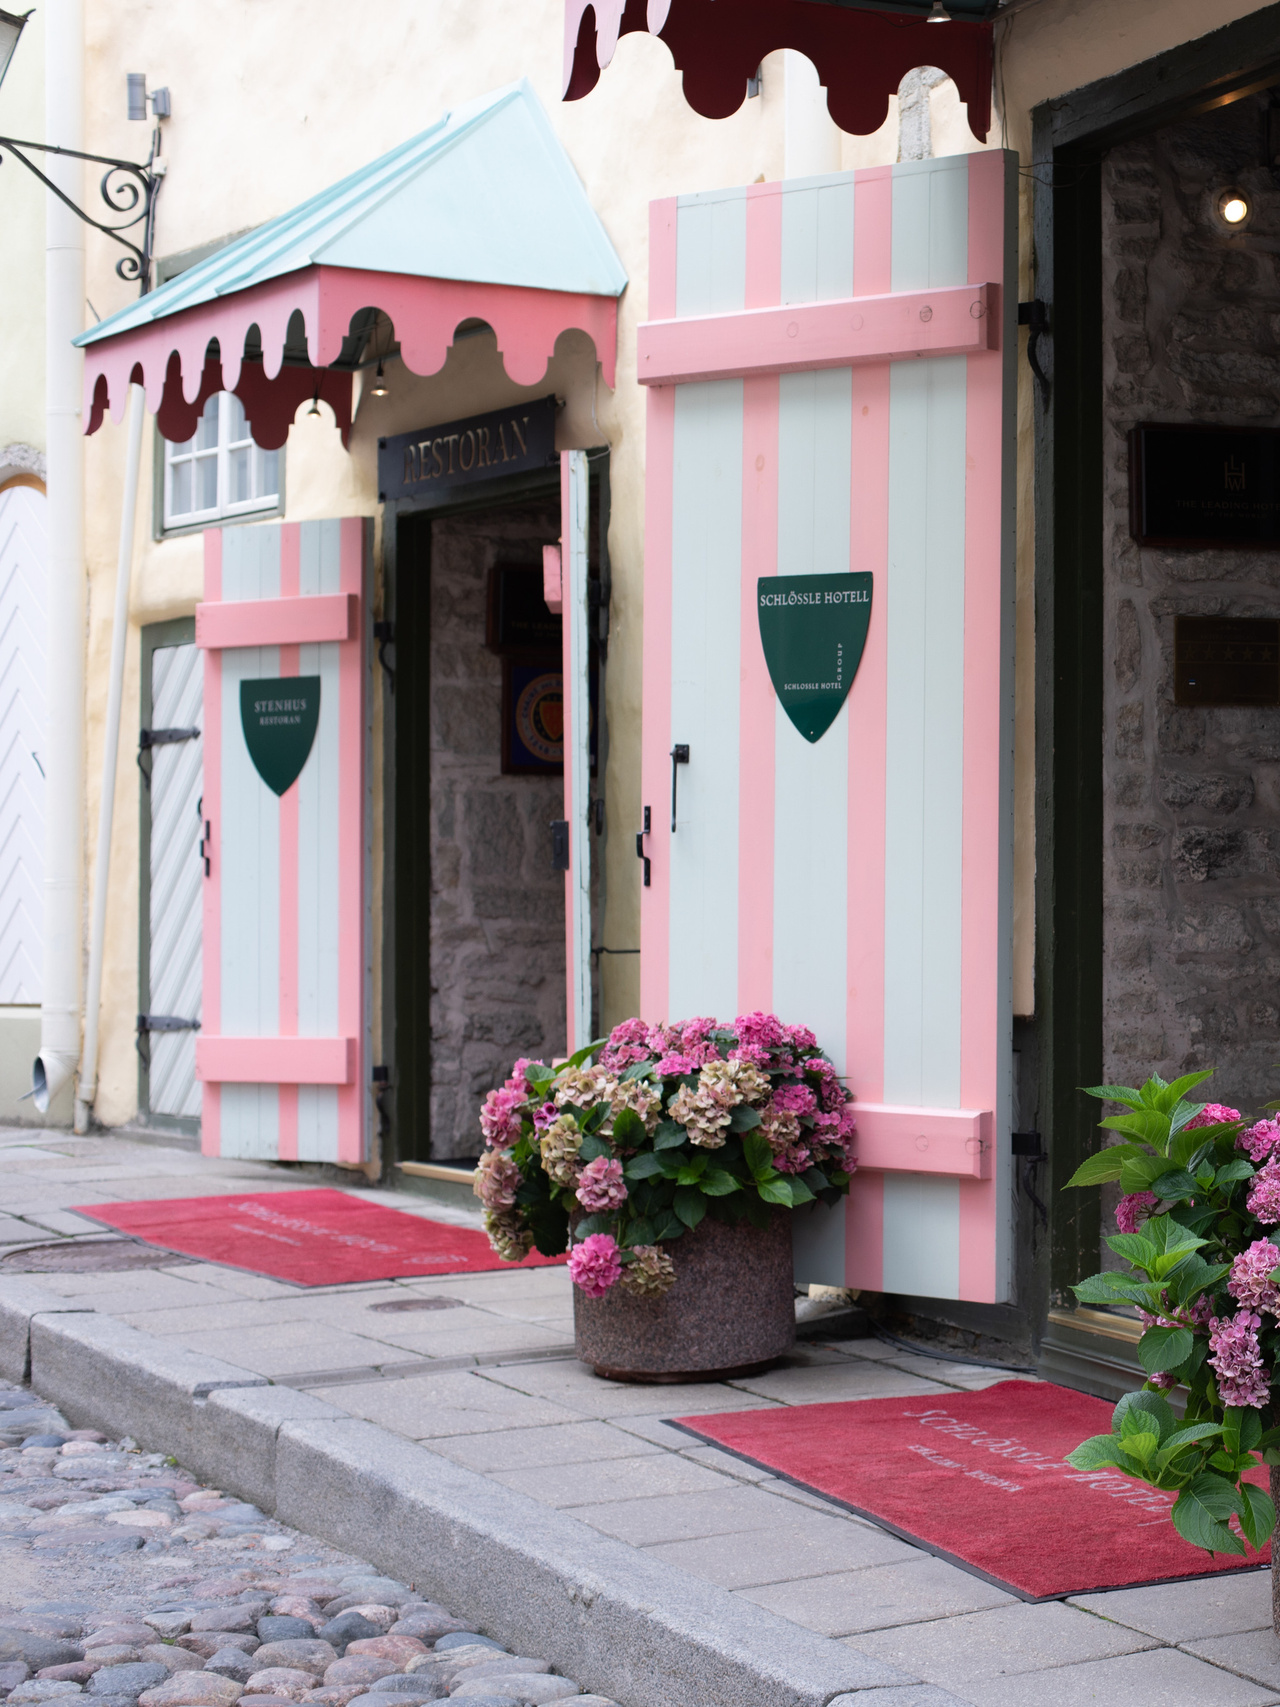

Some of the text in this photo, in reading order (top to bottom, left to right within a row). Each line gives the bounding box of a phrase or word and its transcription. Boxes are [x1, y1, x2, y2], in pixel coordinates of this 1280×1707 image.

[403, 416, 530, 485] RESTORAN
[1175, 499, 1197, 510] THE
[1201, 501, 1249, 511] LEADING
[760, 590, 870, 607] SCHLÖSSLE HOTELL
[254, 698, 307, 713] STENHUS
[259, 715, 301, 726] RESTORAN
[903, 1409, 1073, 1470] SCHLÖSSLE
